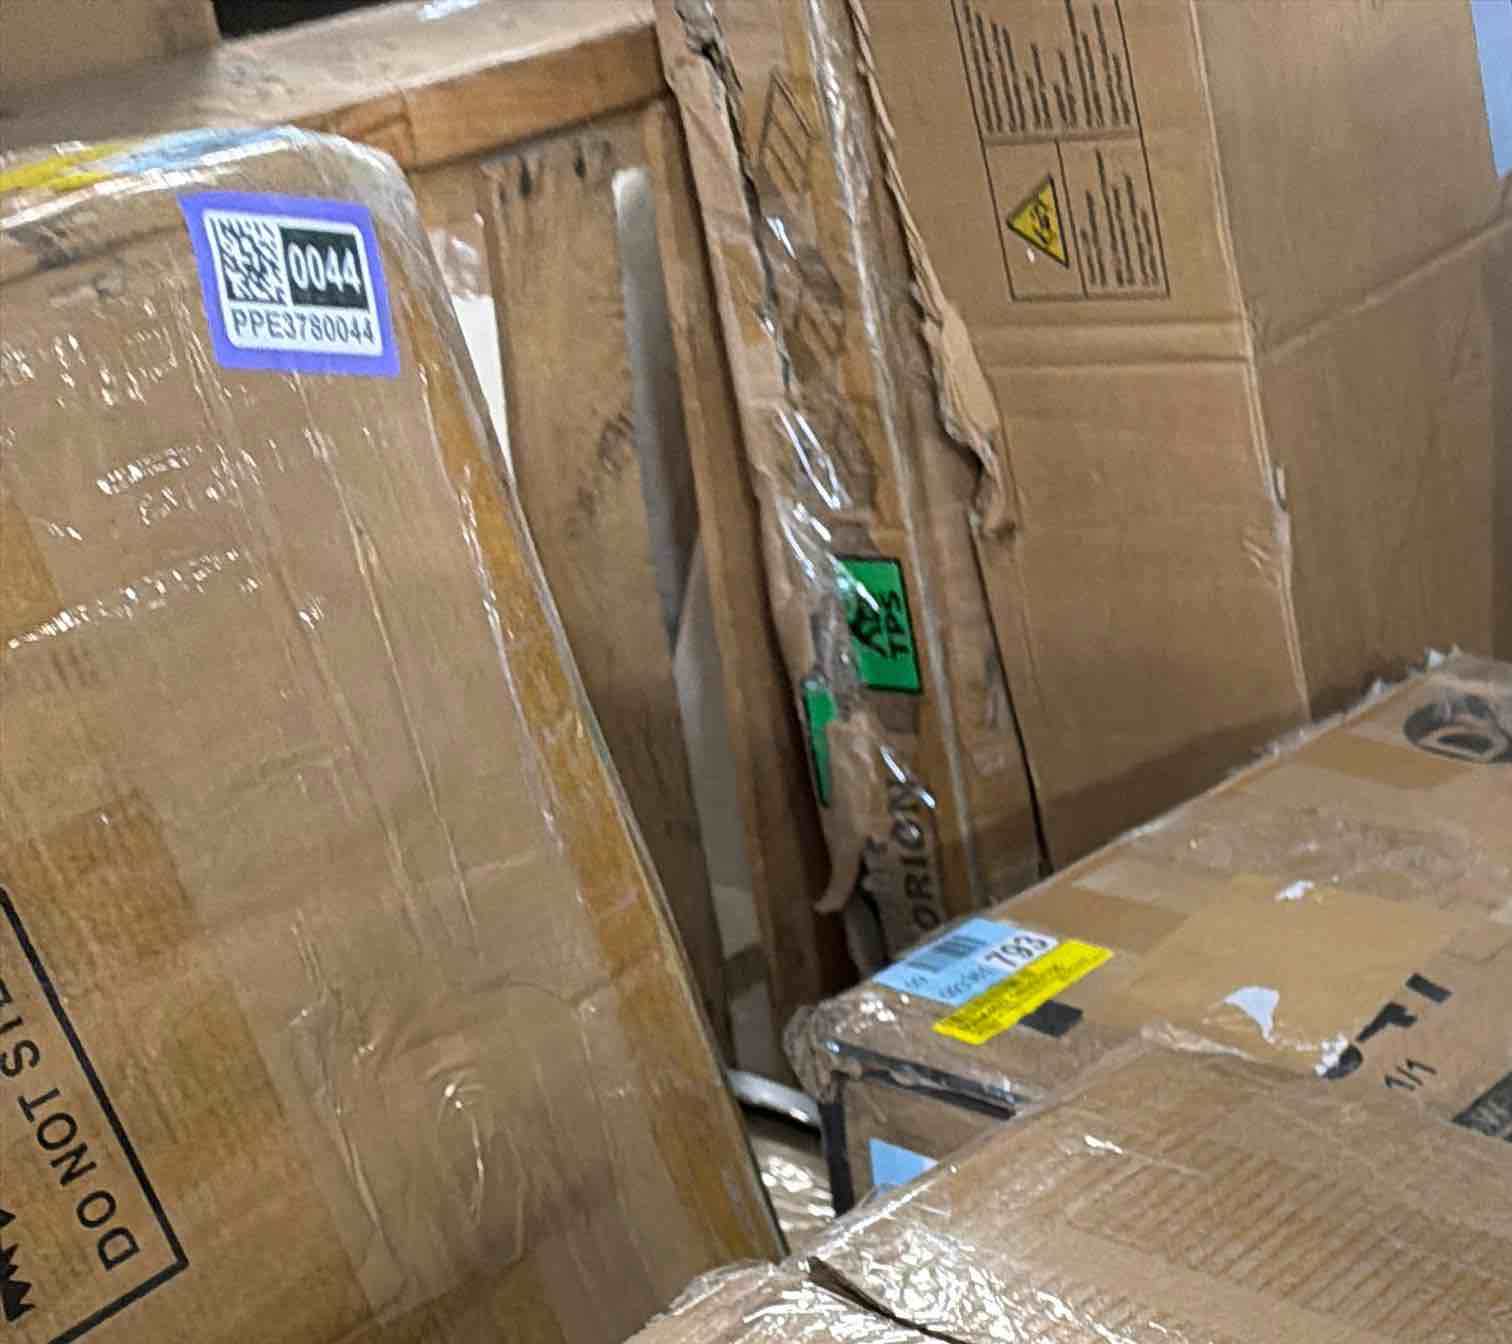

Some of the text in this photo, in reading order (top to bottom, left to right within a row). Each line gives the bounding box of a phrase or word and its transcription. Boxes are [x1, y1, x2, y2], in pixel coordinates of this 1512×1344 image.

[286, 241, 362, 294] 0044
[17, 1086, 97, 1187] NOT
[76, 1189, 141, 1271] DO
